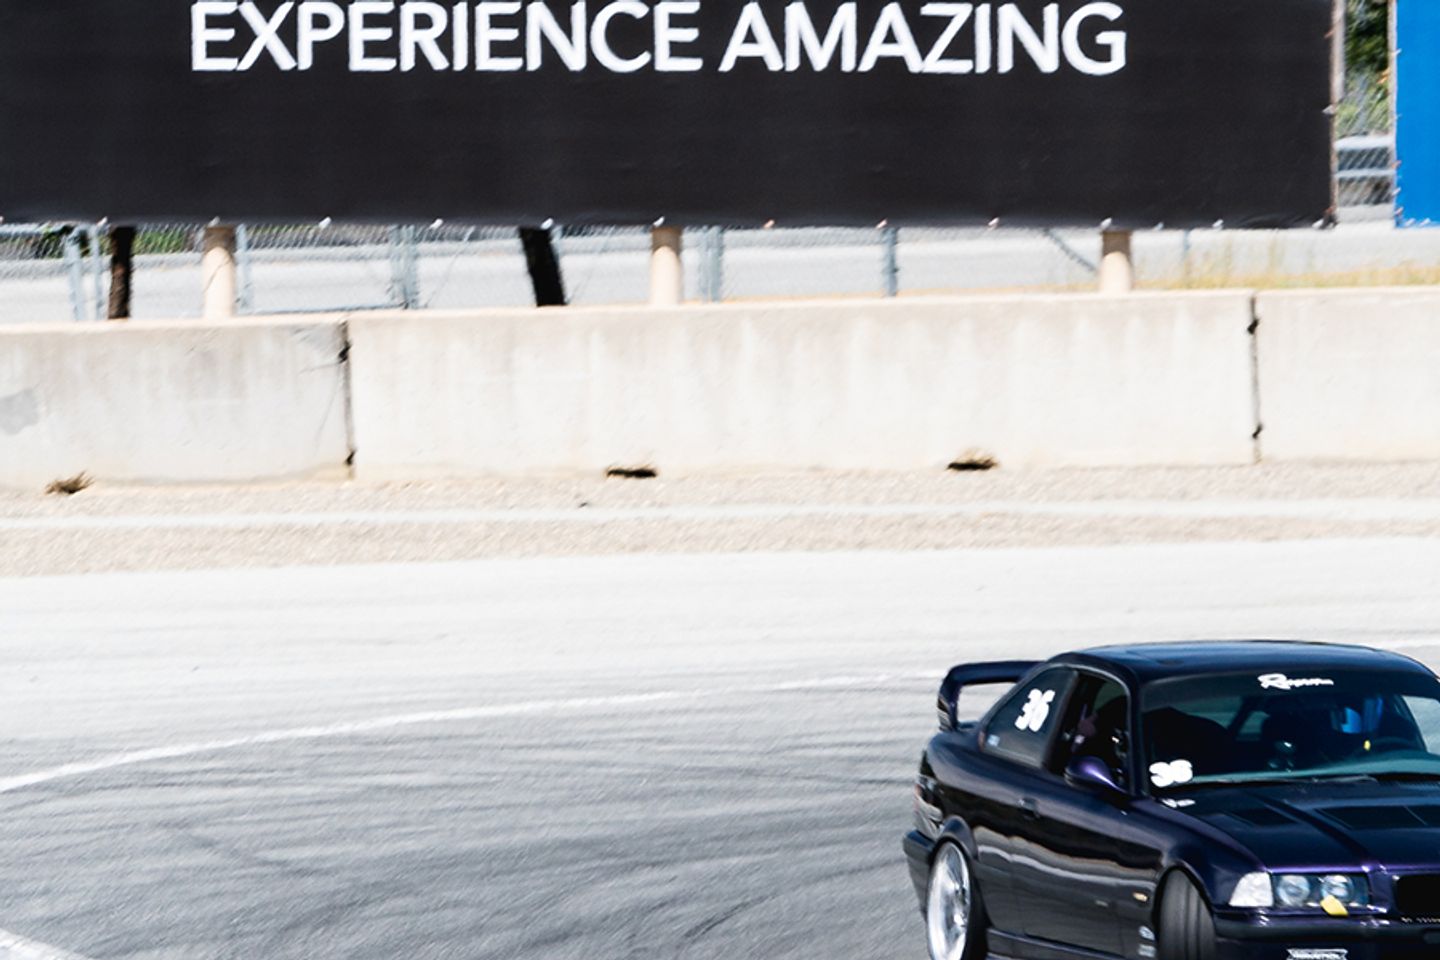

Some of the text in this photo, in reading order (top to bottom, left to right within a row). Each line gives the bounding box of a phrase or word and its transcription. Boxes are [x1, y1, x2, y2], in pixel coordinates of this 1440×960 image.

[191, 0, 1127, 75] EXPERIENCE AMAZING
[1014, 688, 1056, 732] 36
